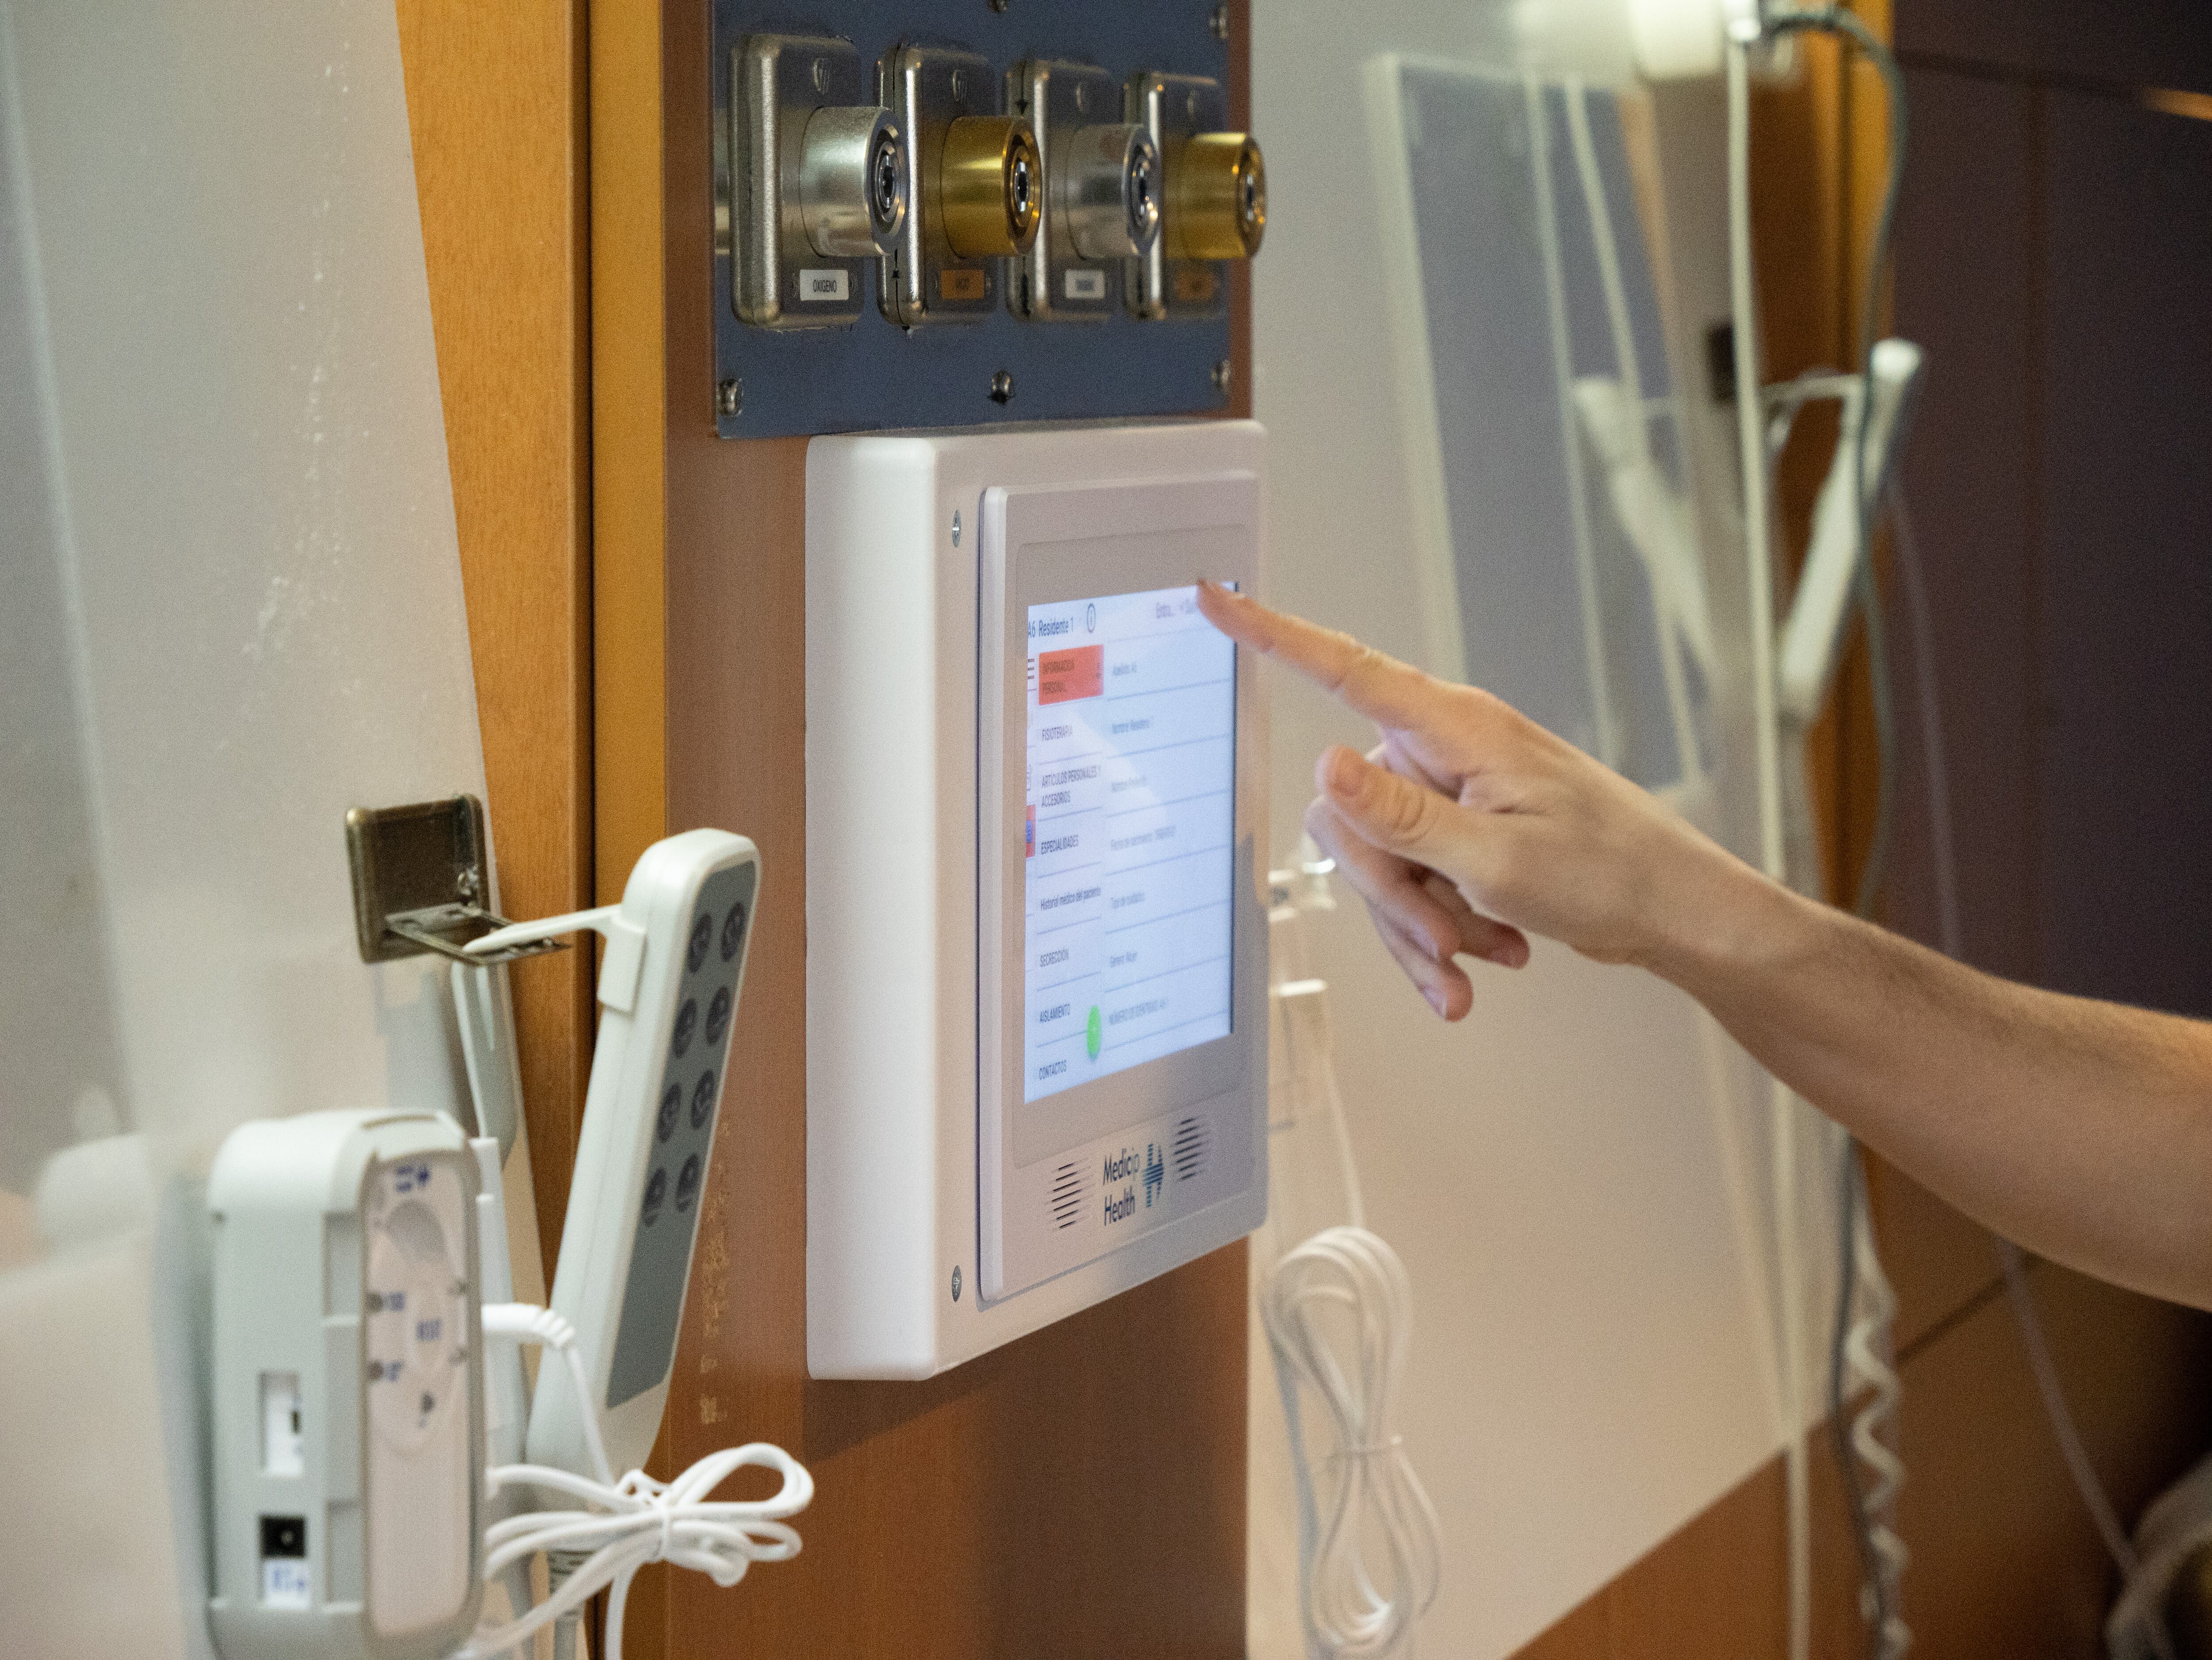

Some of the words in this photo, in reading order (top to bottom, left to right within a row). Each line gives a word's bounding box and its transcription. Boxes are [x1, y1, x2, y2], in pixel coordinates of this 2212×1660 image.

[813, 279, 837, 293] OXIGENO
[1038, 618, 1069, 637] Residente
[1041, 834, 1079, 855] ESPECIALIDADES
[1039, 1003, 1071, 1023] AISLAMIENTO
[1039, 1059, 1068, 1080] CONTACTOS
[1103, 1147, 1140, 1186] Medicip
[1104, 1185, 1136, 1226] Health
